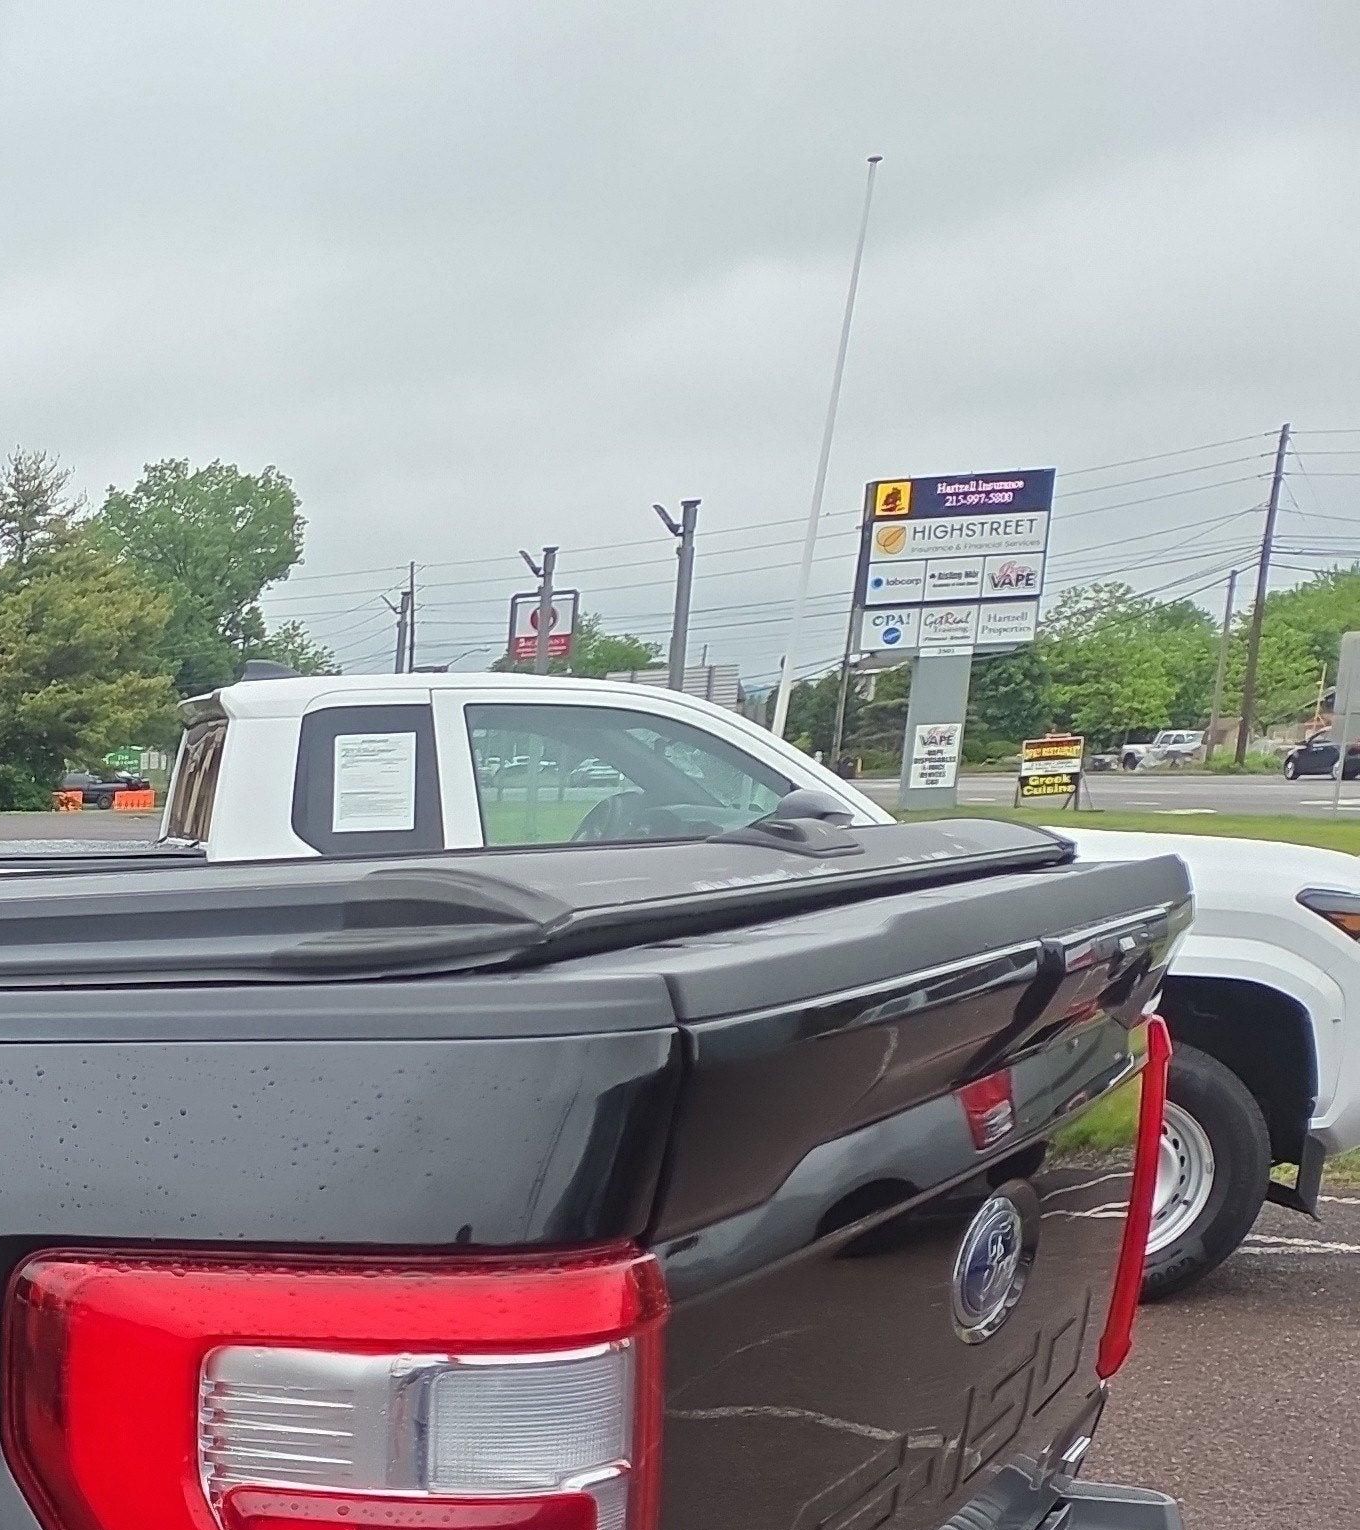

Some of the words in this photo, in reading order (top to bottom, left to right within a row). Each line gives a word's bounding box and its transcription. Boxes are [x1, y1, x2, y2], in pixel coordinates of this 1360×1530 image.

[912, 518, 1038, 541] HIGHSTREET
[1005, 538, 1040, 548] Services
[886, 577, 922, 587] labcorp
[987, 573, 1037, 589] VAPE
[872, 613, 911, 627] OPA!
[919, 734, 955, 746] VAPE
[1028, 774, 1072, 786] Greek
[1023, 783, 1076, 796] Cuisine
